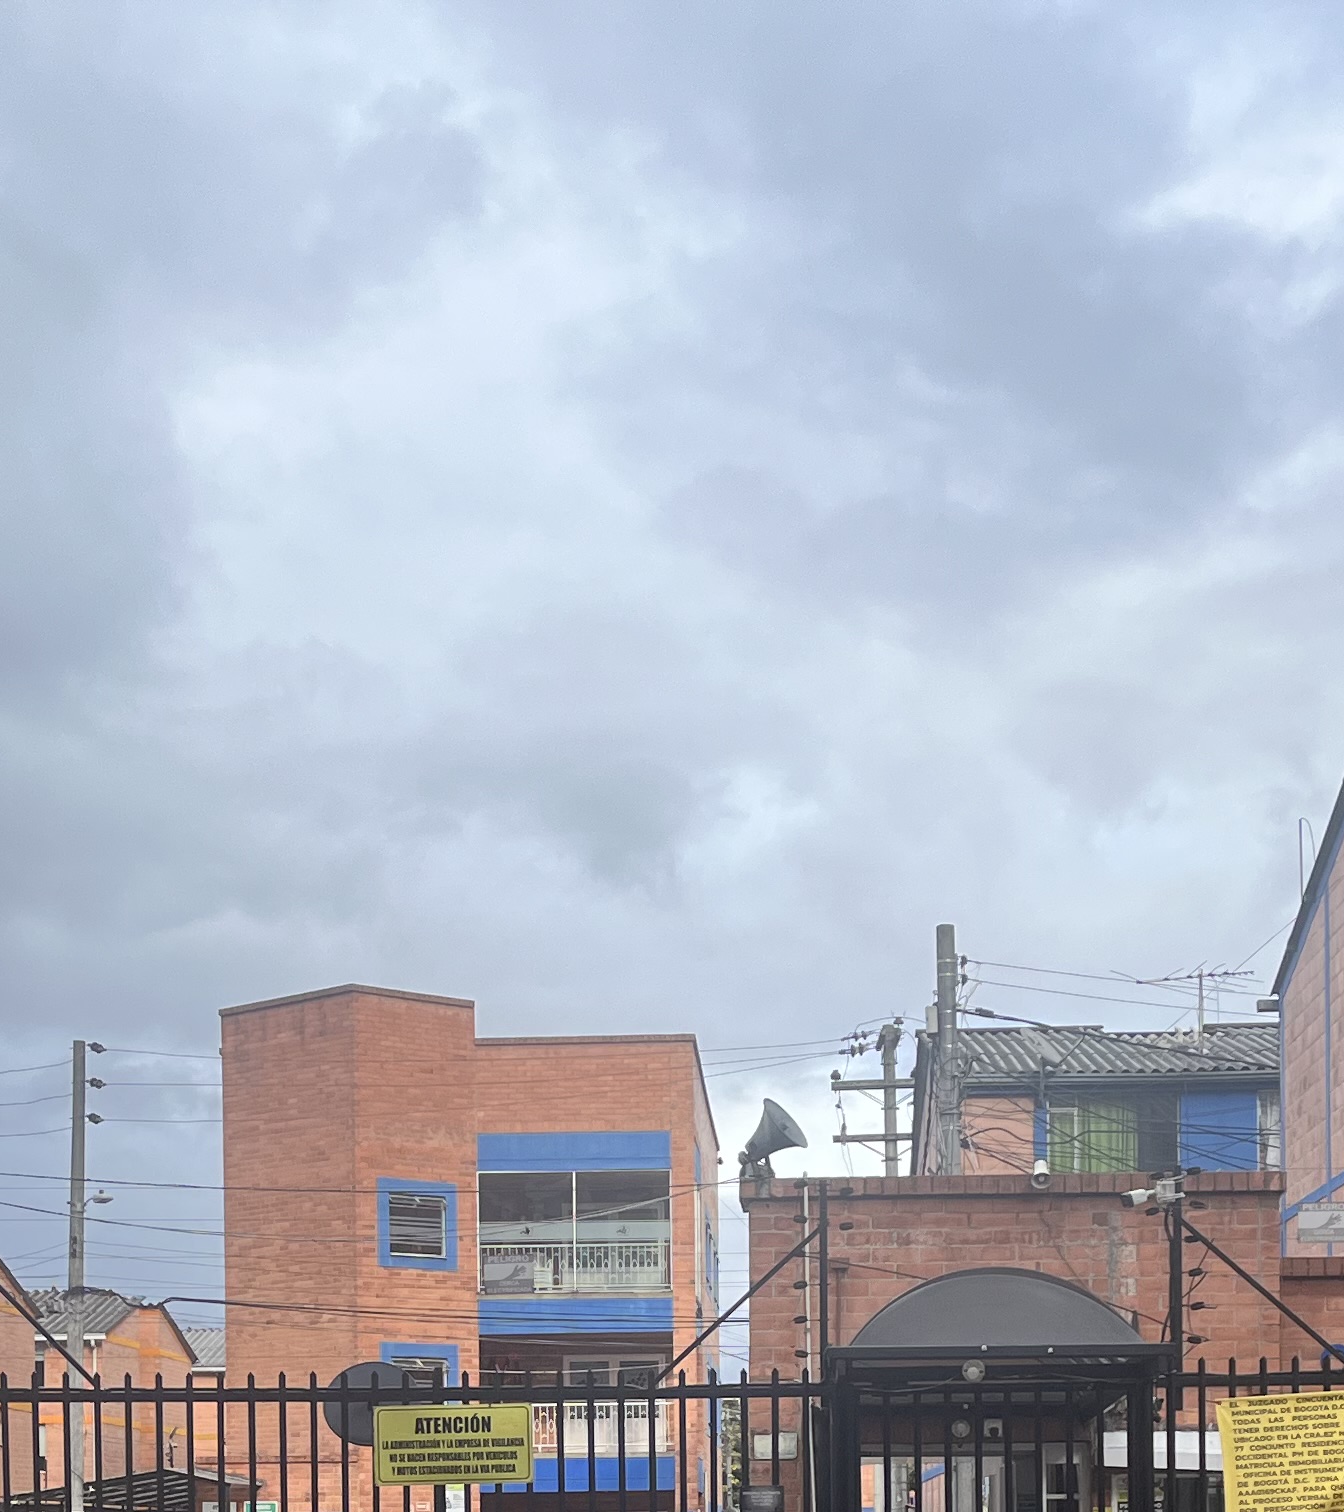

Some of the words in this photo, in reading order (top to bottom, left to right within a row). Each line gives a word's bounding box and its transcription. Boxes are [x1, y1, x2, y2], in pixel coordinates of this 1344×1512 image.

[1248, 1399, 1288, 1407] JUZGADO
[1296, 1395, 1344, 1403] CINCUENTA
[1292, 1413, 1337, 1421] PERSONAS
[415, 1413, 491, 1434] ATENCIÓN
[1263, 1424, 1309, 1432] DERECHOS
[1250, 1443, 1295, 1451] CONJUNTO
[1235, 1452, 1288, 1461] OCCIDENTAL
[1264, 1503, 1325, 1512] PRESCRIPCIÓN
